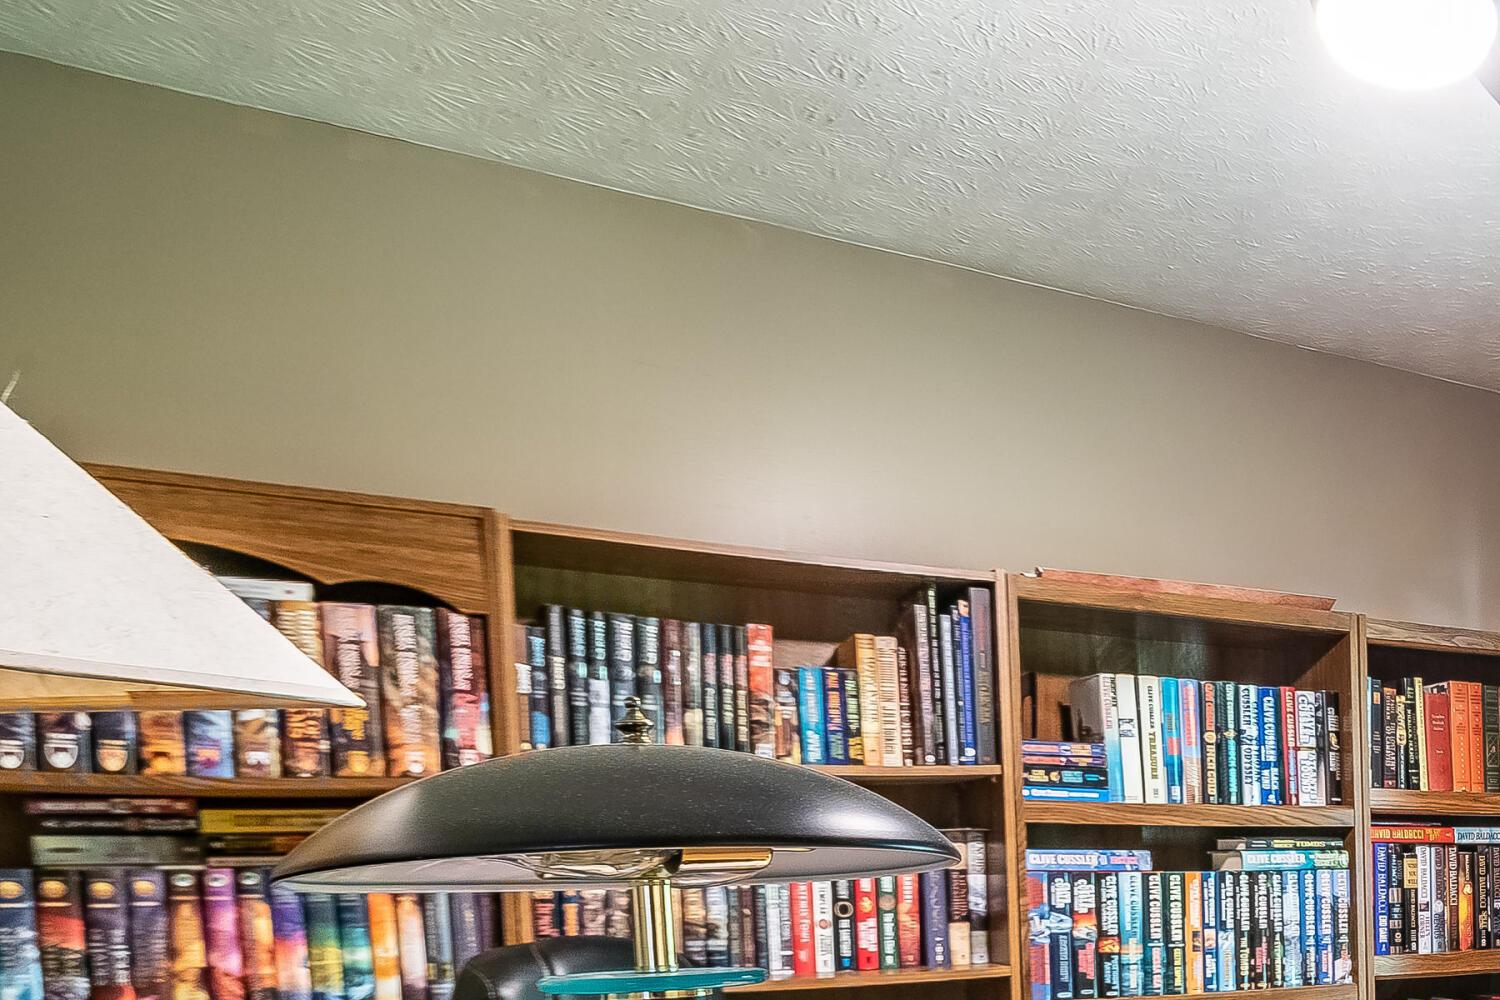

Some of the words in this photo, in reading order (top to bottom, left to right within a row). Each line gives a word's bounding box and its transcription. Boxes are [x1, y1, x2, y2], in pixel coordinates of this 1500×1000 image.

[1263, 697, 1276, 724] CLIVE
[1285, 691, 1294, 713] CLIVE
[1264, 724, 1277, 761] CUSSLER
[1286, 714, 1296, 747] CUSSLER
[1243, 748, 1254, 785] ODYSSEY
[1028, 854, 1059, 865] CLIVE
[1061, 853, 1098, 866] CUSSLER
[1246, 854, 1271, 864] CLIVE
[1377, 846, 1387, 871] DAVID
[1420, 847, 1428, 864] DAVID
[1448, 847, 1457, 869] DAVID
[1479, 855, 1487, 874] DAVID
[1493, 847, 1500, 865] DAVID
[1106, 876, 1117, 897] CLIVE
[1149, 875, 1160, 900] CLIVE
[1169, 874, 1181, 900] CLIVE
[1305, 873, 1314, 896] CLIVE
[1321, 873, 1331, 896] CLIVE
[1378, 873, 1388, 913] BALDACCI
[1421, 865, 1429, 898] BALDACCI
[1449, 870, 1459, 905] BALDACCI
[1479, 877, 1487, 908] BALDACCI
[1493, 867, 1500, 898] BALDACCI
[1106, 900, 1118, 935] CUSSLER
[1150, 901, 1161, 939] CUSSLER
[1170, 902, 1182, 941] CUSSLER
[1240, 897, 1250, 931] CUSSLER
[1259, 897, 1268, 929] CUSSLER
[1305, 899, 1315, 936] CUSSLER
[1321, 897, 1331, 934] CUSSLER
[1338, 897, 1349, 933] CUSSLER
